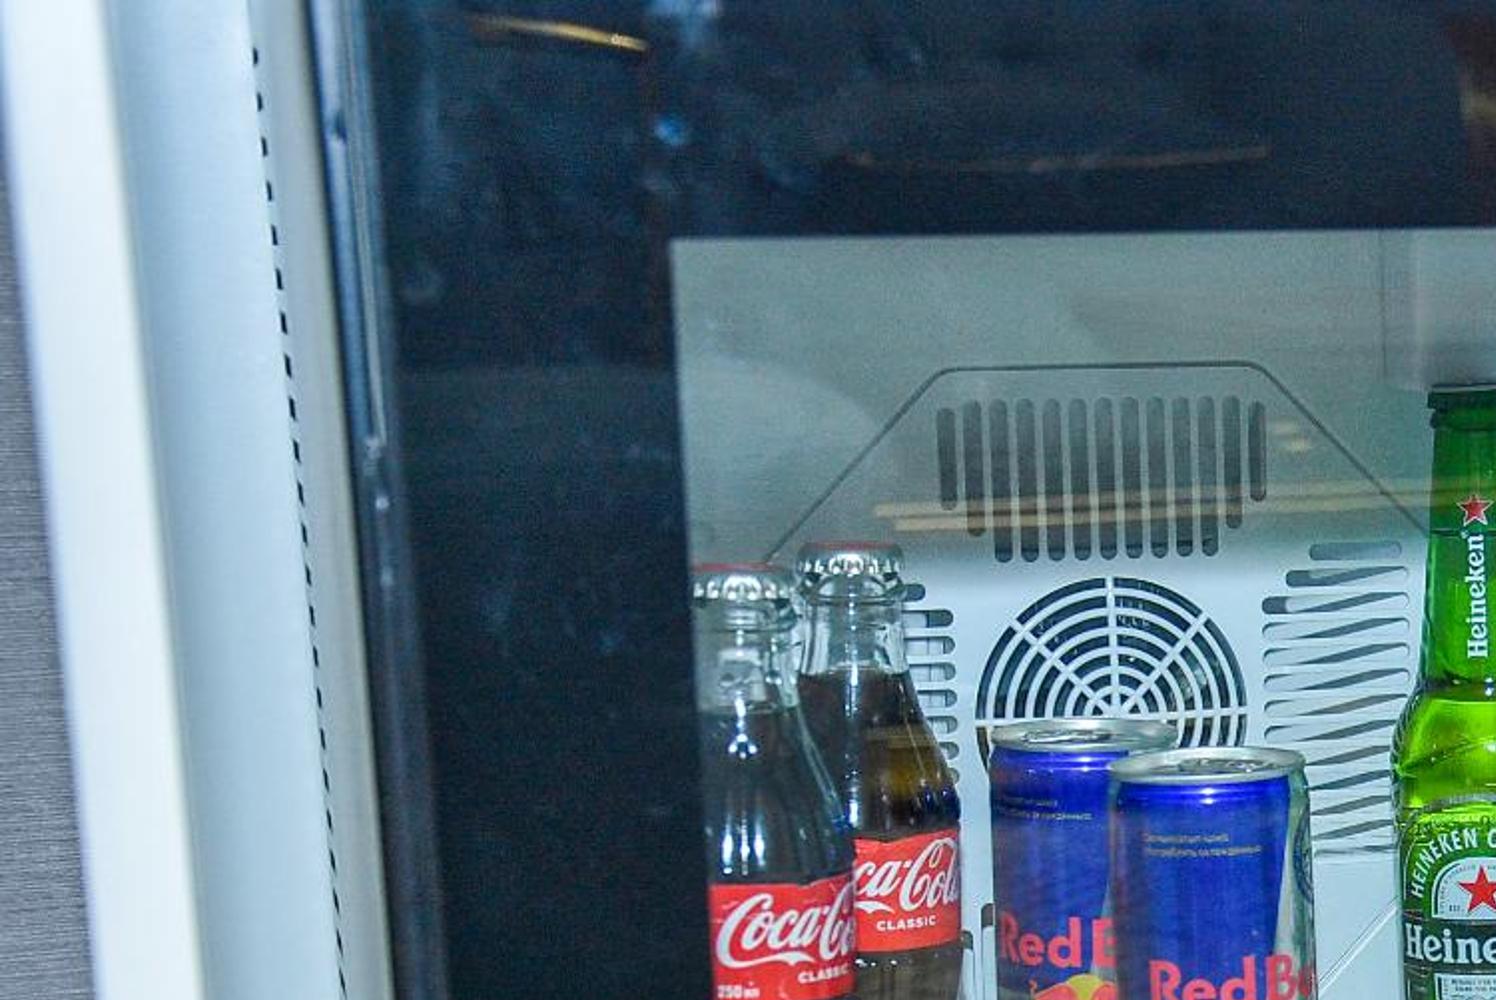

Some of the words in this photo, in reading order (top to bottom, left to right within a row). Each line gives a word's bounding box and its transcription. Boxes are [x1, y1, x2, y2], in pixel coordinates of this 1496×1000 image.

[1467, 534, 1489, 658] Heineken
[1411, 828, 1478, 898] HEINEKEN
[876, 915, 937, 932] CLASSIC
[1000, 910, 1083, 967] Red
